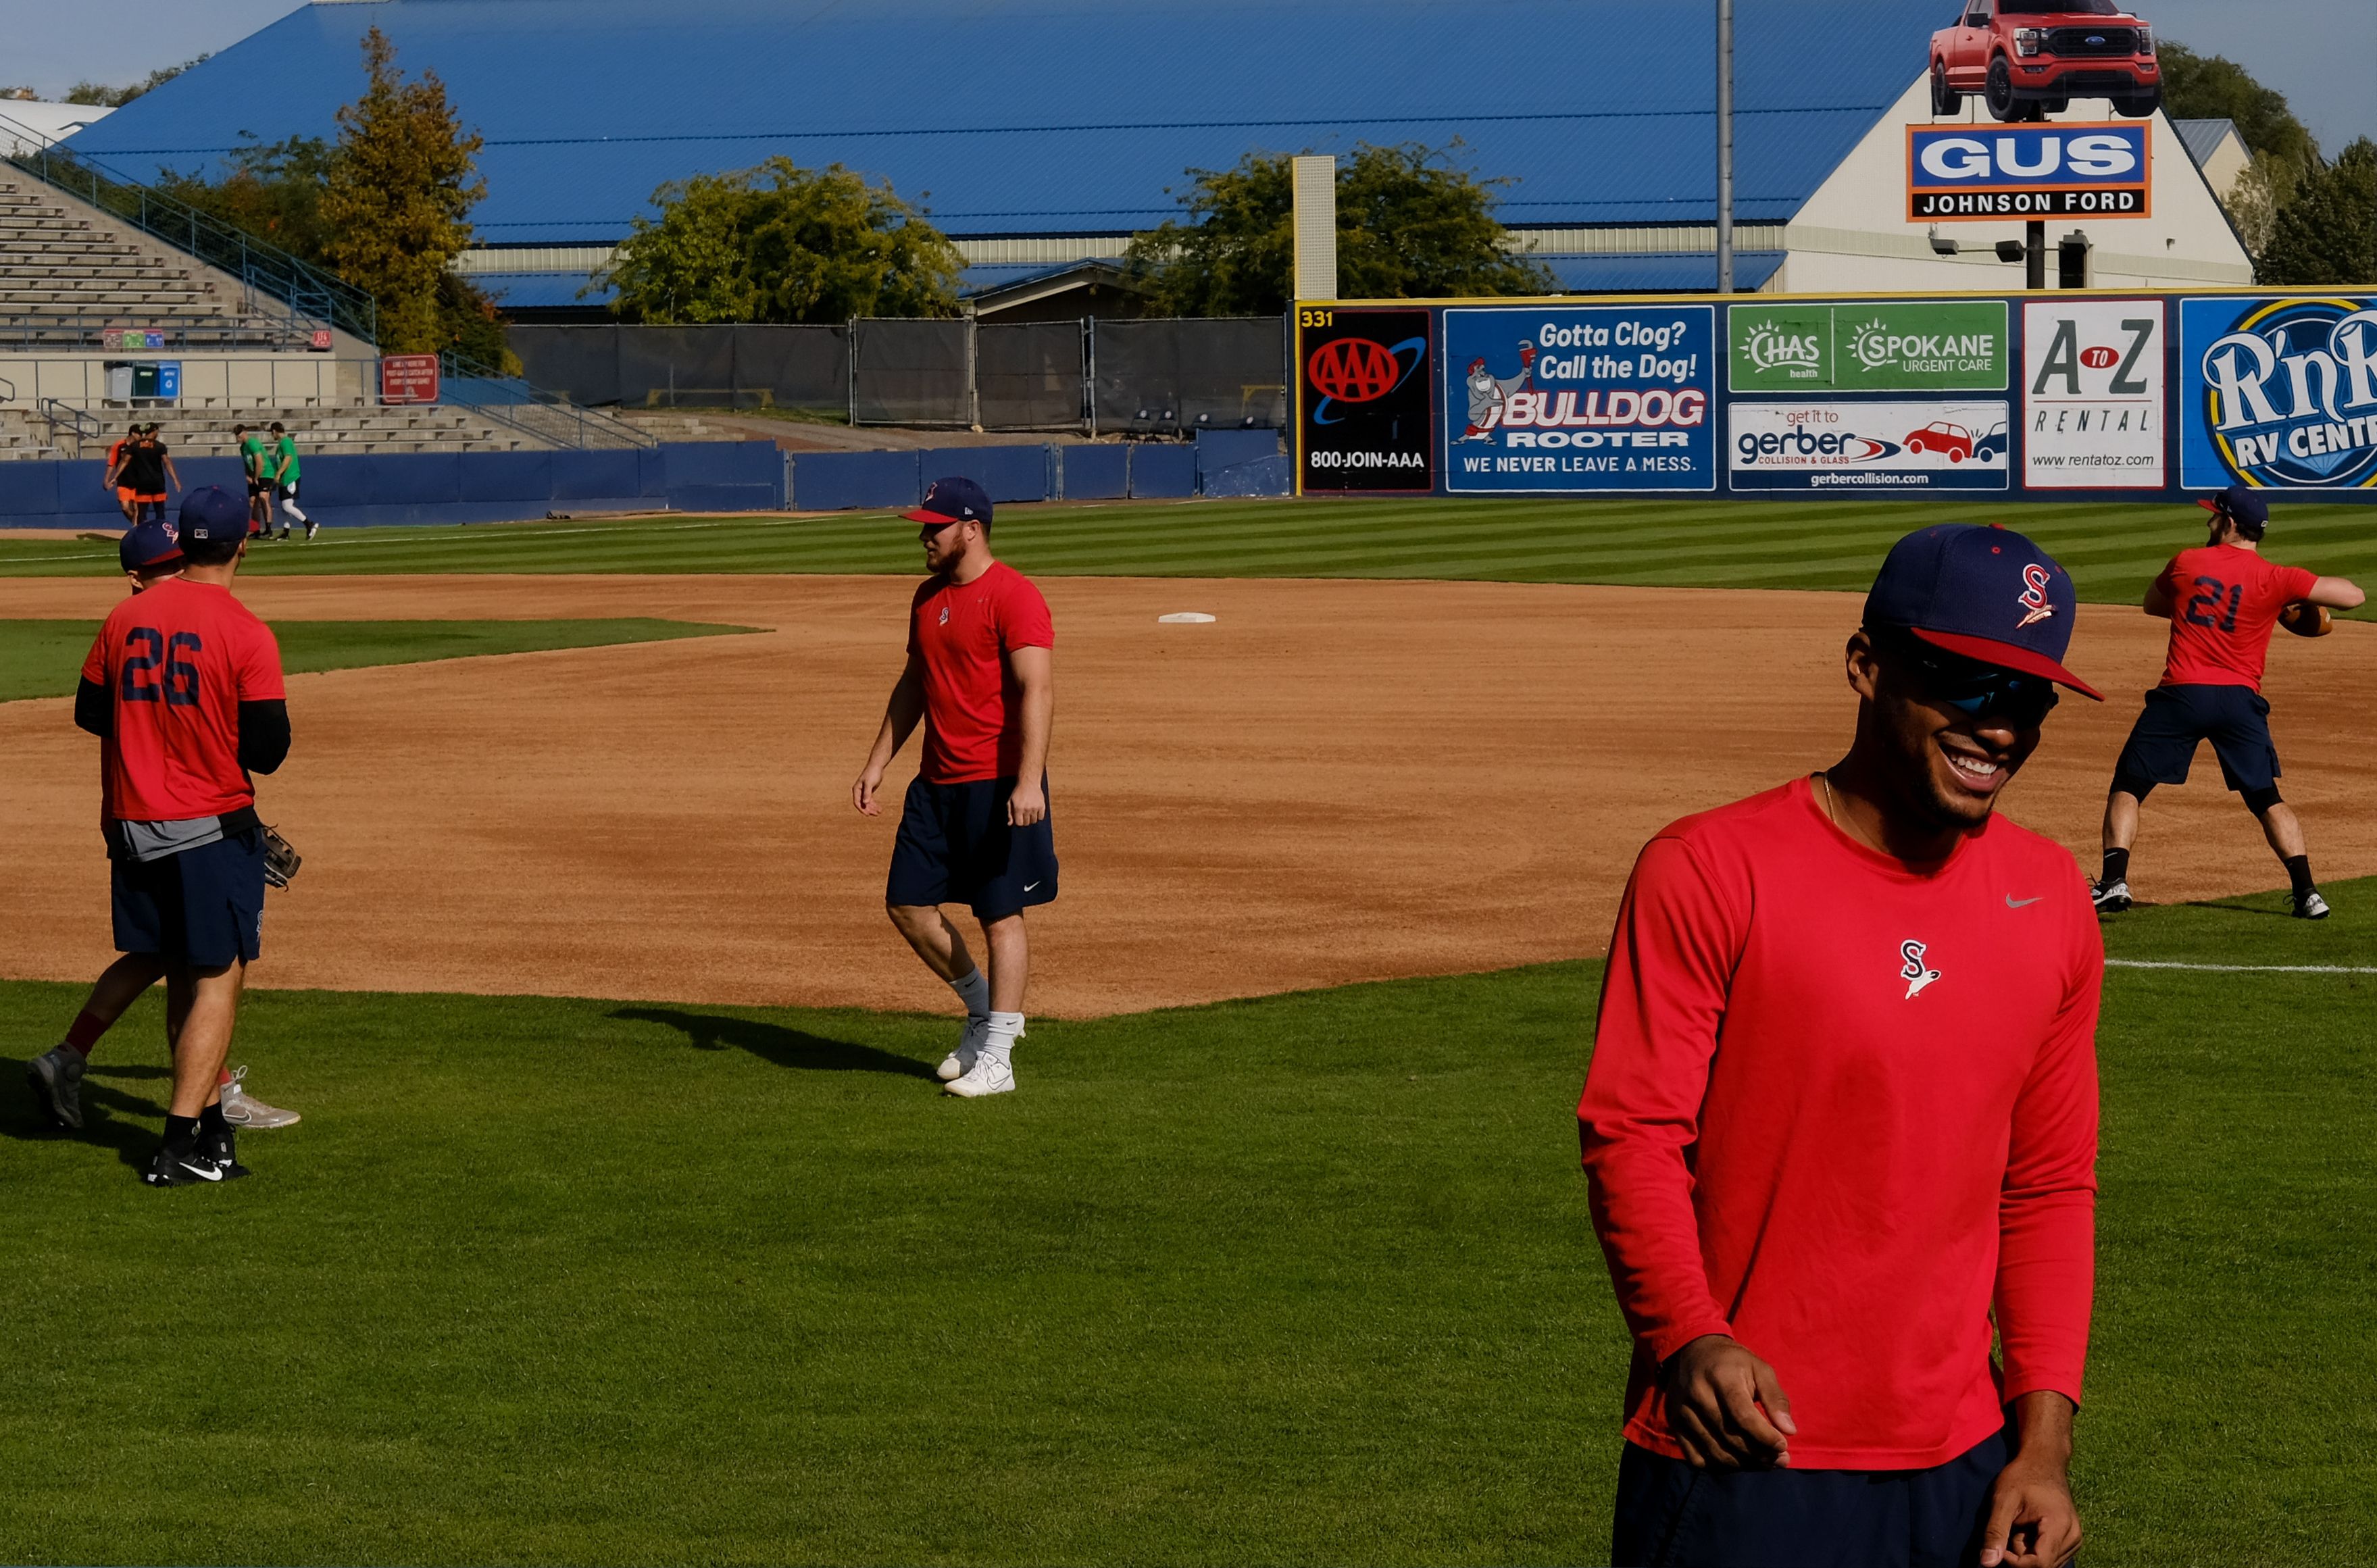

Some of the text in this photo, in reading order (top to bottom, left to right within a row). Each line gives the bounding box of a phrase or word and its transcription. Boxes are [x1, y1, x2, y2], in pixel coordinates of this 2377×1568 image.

[1921, 135, 2135, 178] GUS
[1923, 193, 2134, 213] JOHNSON FORD
[1301, 311, 1333, 328] 331
[1539, 321, 1686, 351] Gotta Clog?
[1868, 335, 1994, 359] SPOKANE
[1314, 339, 1392, 400] AAA
[1540, 354, 1697, 383] Call the Dog!
[1903, 359, 1992, 372] URGENT CARE
[2032, 319, 2154, 395] A TO Z
[1790, 370, 1818, 378] health
[1502, 389, 1706, 428] BULLDOG
[1787, 410, 1838, 426] get it to
[2035, 410, 2147, 432] RENTAL
[1507, 431, 1689, 448] ROOTER
[1738, 425, 1857, 464] gerber
[2235, 432, 2279, 467] RV
[1311, 451, 1424, 467] 800-JOIN-AAA
[1463, 457, 1697, 472] WE NEVER LEAVE A MESS.
[1811, 473, 1928, 486] gerbercollision.com
[2018, 563, 2050, 611] S
[2186, 576, 2243, 633] 21
[122, 627, 202, 707] 26
[1900, 939, 1926, 982] S
